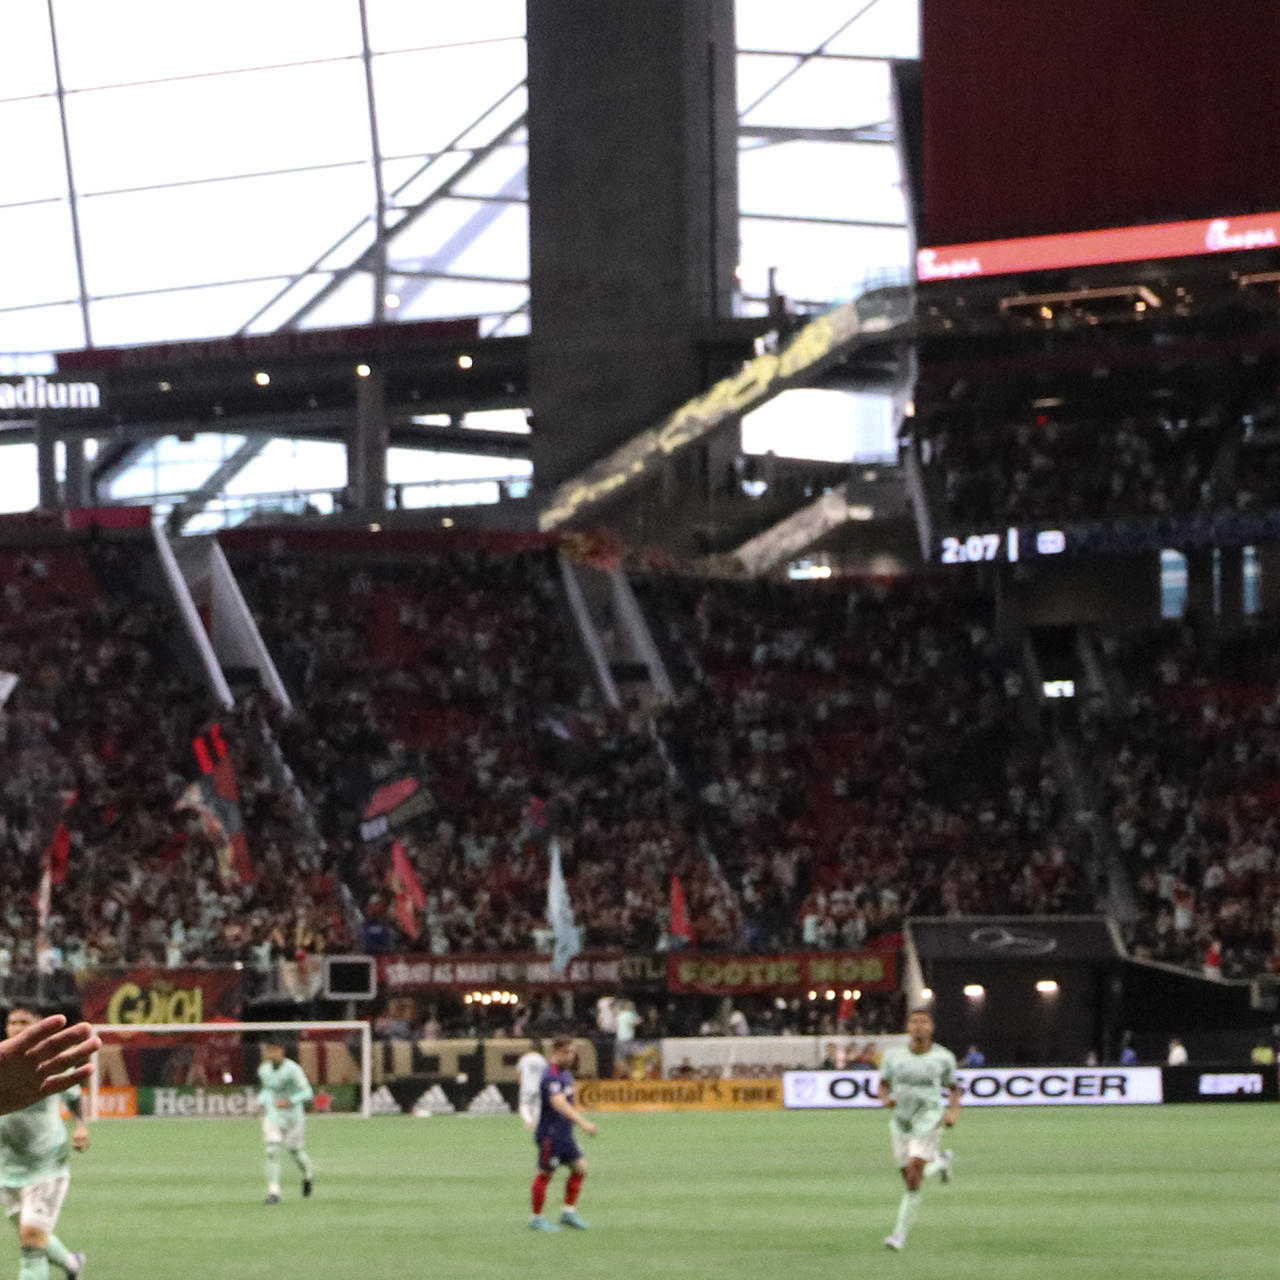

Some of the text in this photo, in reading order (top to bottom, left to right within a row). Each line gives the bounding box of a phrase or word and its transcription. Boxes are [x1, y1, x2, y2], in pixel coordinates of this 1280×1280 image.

[942, 534, 1000, 563] 2:07
[578, 1084, 704, 1106] Continental
[829, 1077, 881, 1100] OU
[1199, 1073, 1263, 1095] ESPN
[153, 1086, 260, 1116] Heinek
